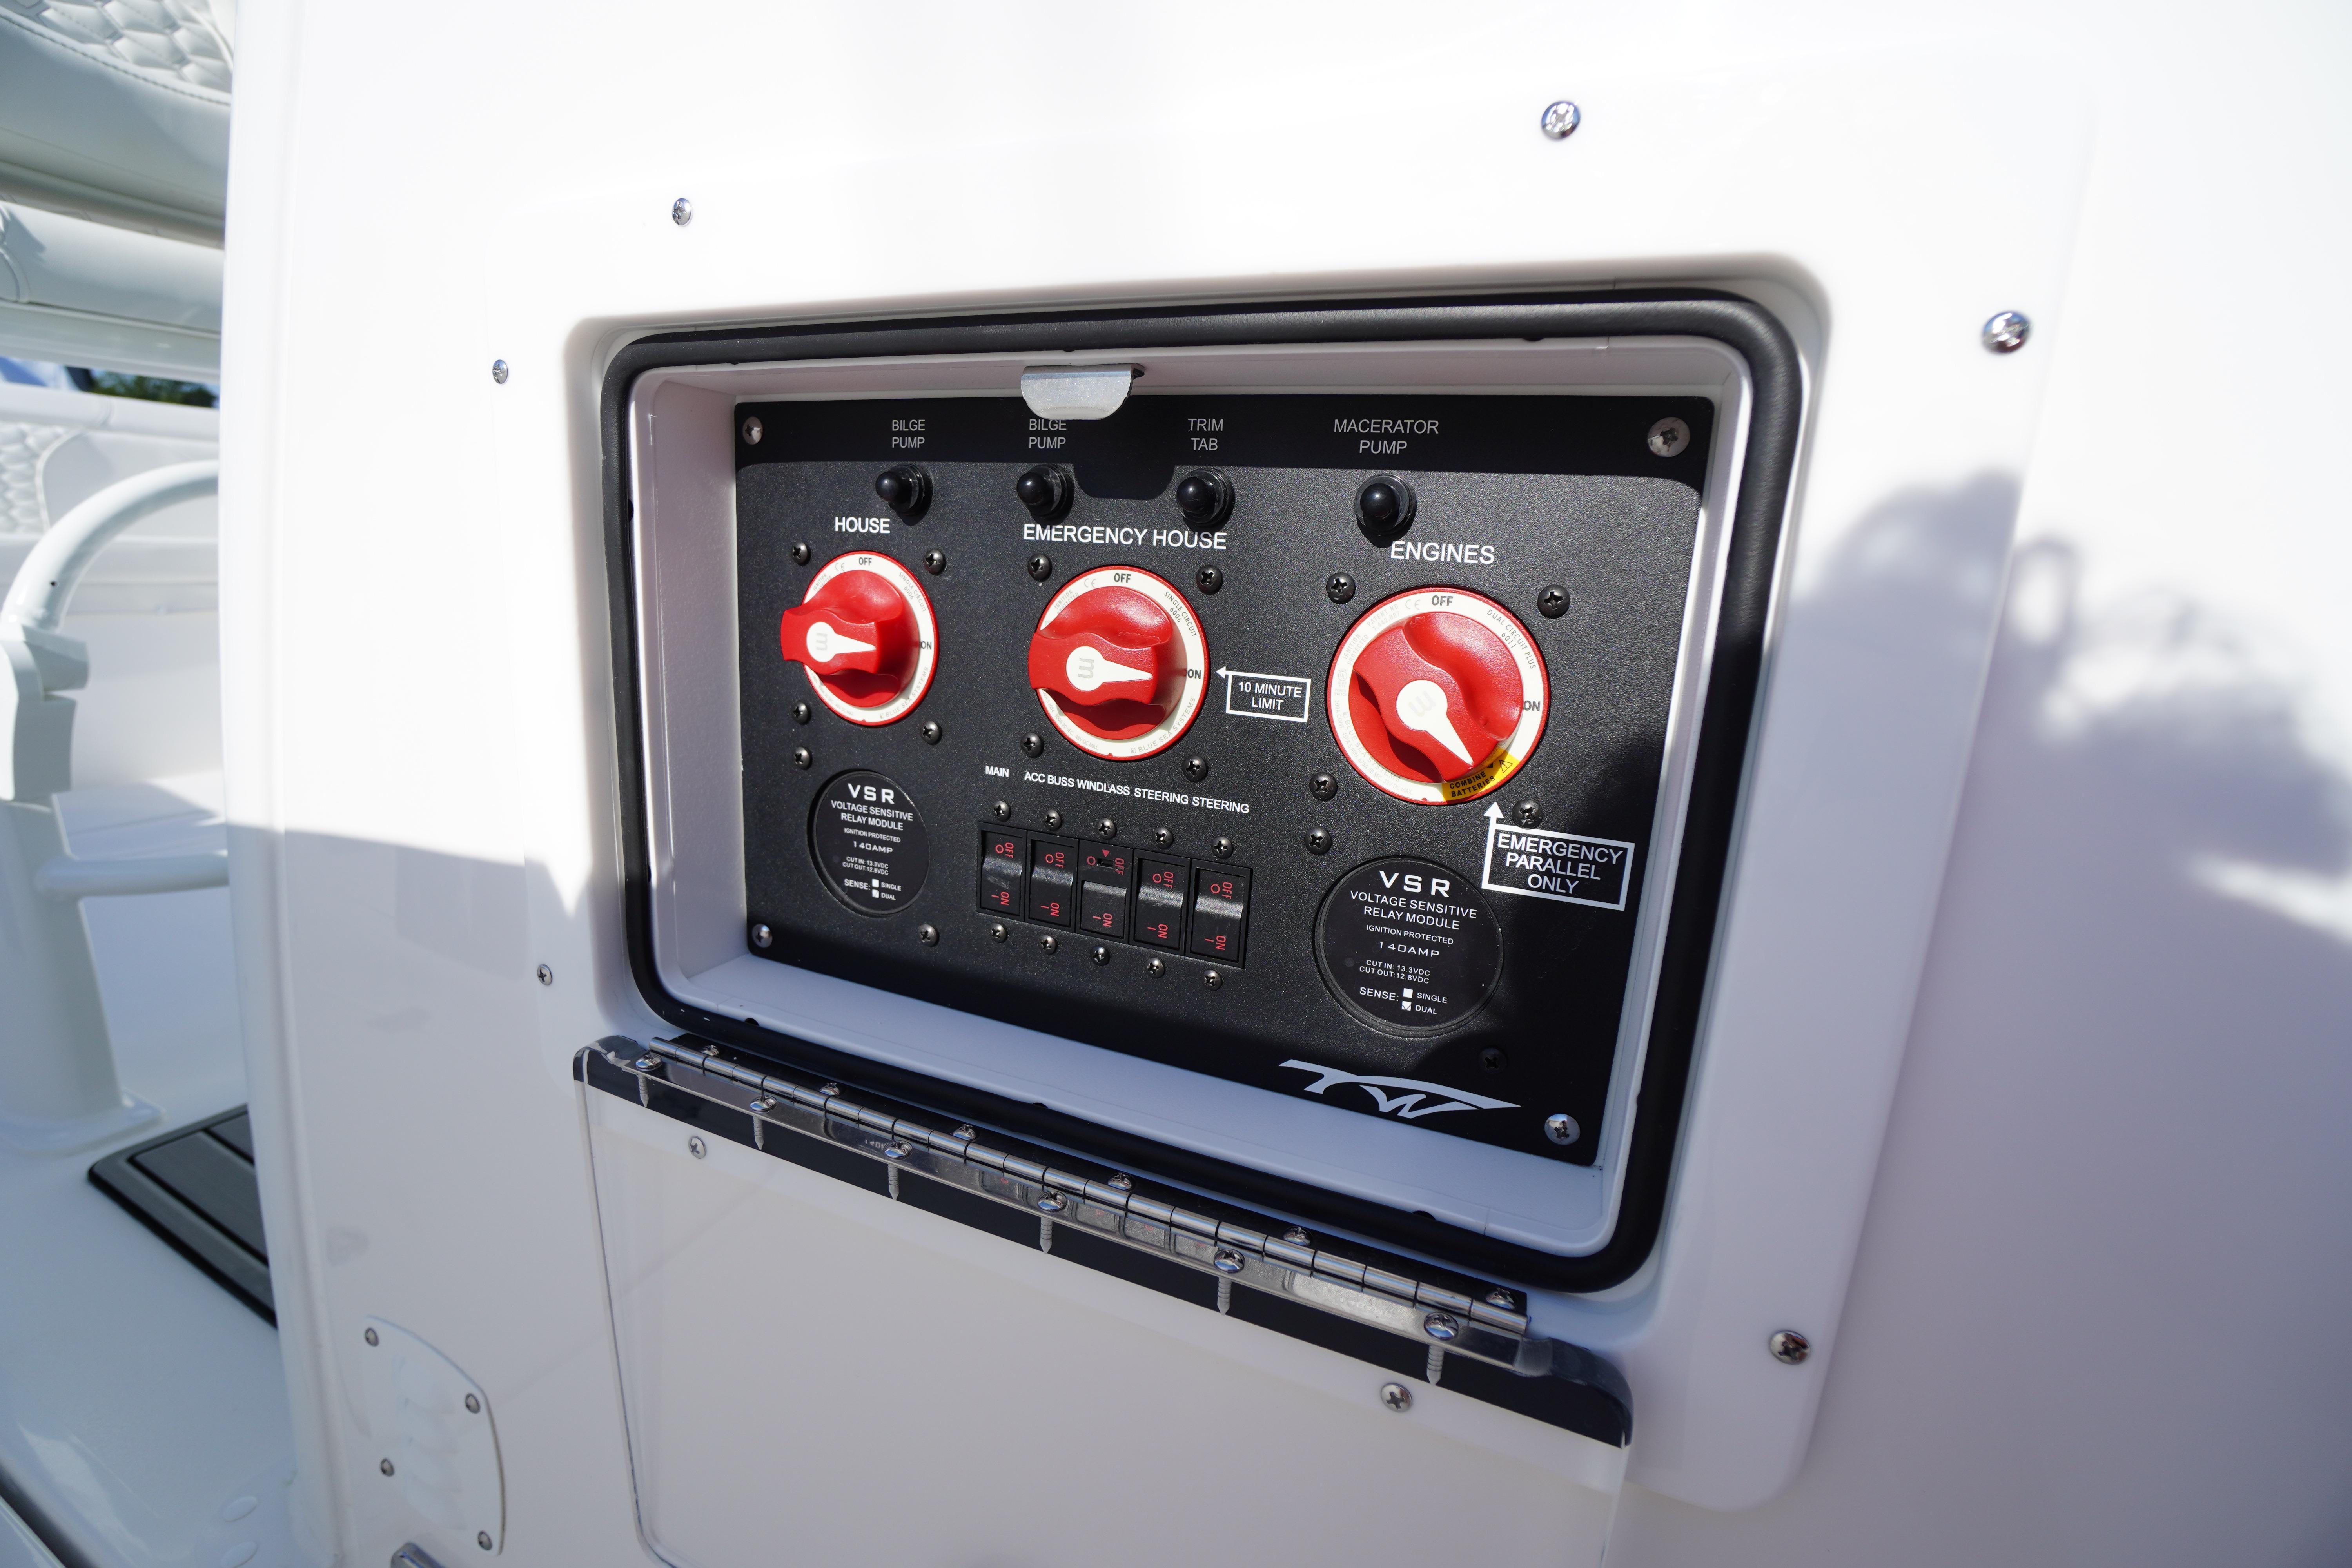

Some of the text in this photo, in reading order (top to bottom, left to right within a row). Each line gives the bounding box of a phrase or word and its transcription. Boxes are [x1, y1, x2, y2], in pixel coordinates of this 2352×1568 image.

[891, 419, 926, 431] BILGE
[1029, 419, 1067, 430] BILGE
[1188, 418, 1223, 431] TRIM
[1334, 418, 1439, 434] MACERATOR
[891, 437, 925, 448] PUMP
[1029, 437, 1066, 449] PUMP
[1191, 437, 1218, 451] TAB
[1359, 440, 1408, 454] PUMP
[835, 517, 890, 534] HOUSE
[1023, 523, 1227, 550] EMERGENCY HOUSE
[1390, 541, 1495, 564] ENGINES
[858, 557, 872, 566] OFF
[1114, 573, 1132, 583] OFF
[899, 572, 927, 612] SINGLE CIRCUIT
[904, 586, 914, 600] 6006
[1054, 589, 1074, 610] IGNITION
[1431, 595, 1454, 606] OFF
[1164, 591, 1197, 637] SINGLE CIRCUIT
[1169, 607, 1181, 622] 6006
[1366, 603, 1399, 627] PATENT NO
[921, 641, 932, 650] ON
[1342, 633, 1361, 660] IGNITION
[1487, 608, 1536, 670] DUAL CIRCUIT PLUS
[1501, 632, 1517, 649] 6011
[1347, 633, 1369, 666] PROTECTED
[1187, 669, 1201, 679] ON
[885, 706, 901, 718] BLUE
[911, 666, 928, 698] SYSTEMS
[1239, 681, 1303, 698] 10 MINUTE
[1251, 697, 1284, 710] LIMIT
[1524, 700, 1541, 711] ON
[1138, 697, 1196, 753] BLUE SEA SYSTEMS
[1345, 719, 1357, 742] BLUE
[1355, 742, 1368, 758] SEA
[985, 765, 1009, 778] MAIN
[1024, 771, 1075, 787] ACC BUSS
[1076, 778, 1131, 796] WINDLASS
[1450, 771, 1487, 789] COMBINE
[1451, 776, 1495, 798] BATTERIES
[1134, 788, 1189, 805] STEERING
[830, 800, 913, 822] VOLTAGE SENSITIVE
[1192, 796, 1250, 814] STEERING
[840, 812, 904, 831] RELAY MODULE
[844, 827, 901, 843] IGNITION PROTECTED
[1005, 842, 1014, 858] OFF
[1497, 833, 1624, 865] EMERGENCY
[866, 860, 889, 869] 13.3VDC
[1055, 852, 1065, 869] OFF
[1506, 852, 1601, 880] PARALLEL
[881, 882, 902, 891] SINGLE
[1163, 871, 1174, 889] OFF
[1527, 874, 1580, 894] ONLY
[881, 893, 897, 901] DUAL
[1000, 891, 1010, 906] ON
[1222, 881, 1233, 900] OFF
[1050, 902, 1060, 916] ON
[1350, 890, 1478, 919] VOLTAGE SENSITIVE
[1102, 913, 1112, 928] ON
[1363, 906, 1460, 930] RELAY MODULE
[1158, 923, 1169, 939] ON
[1366, 924, 1454, 945] IGNITION PROTECTED
[1215, 935, 1227, 951] ON
[1359, 965, 1377, 975] CUT
[1366, 959, 1430, 976] CUT IN: 13.3VDC
[1359, 986, 1399, 1002] SENSE:
[1417, 992, 1448, 1004] SINGLE
[1415, 1004, 1437, 1015] DUAL
